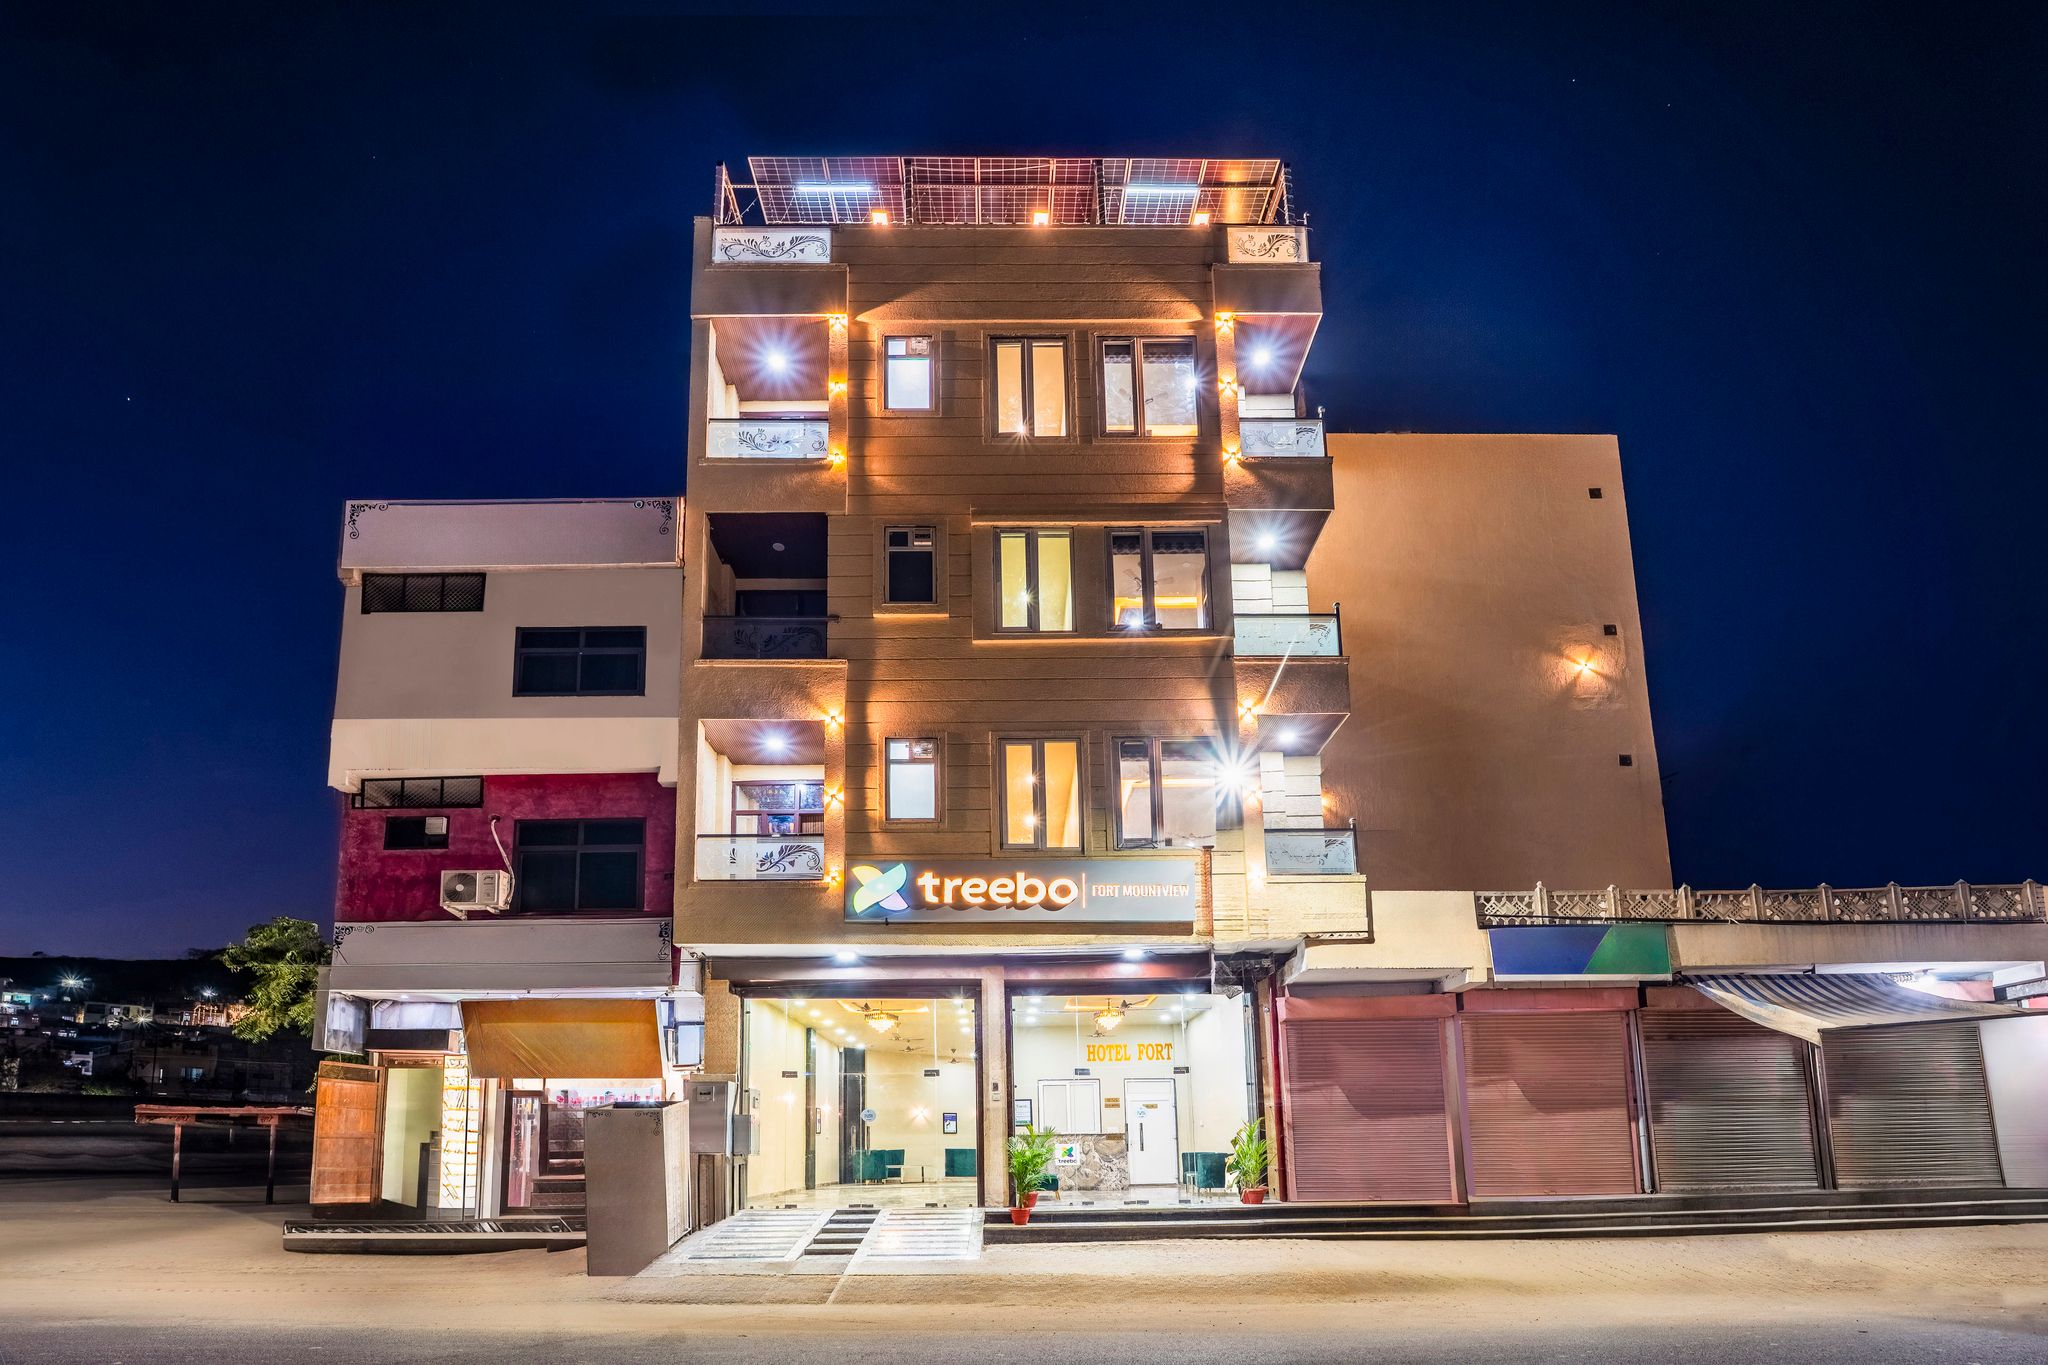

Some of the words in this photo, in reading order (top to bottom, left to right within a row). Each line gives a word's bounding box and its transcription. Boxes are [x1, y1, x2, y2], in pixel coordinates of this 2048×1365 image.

[917, 871, 1078, 904] treebo
[1091, 884, 1120, 897] FORT
[1122, 884, 1190, 897] MOUNTVIEW
[1086, 1043, 1131, 1062] HOTEL
[1137, 1043, 1173, 1061] FORT
